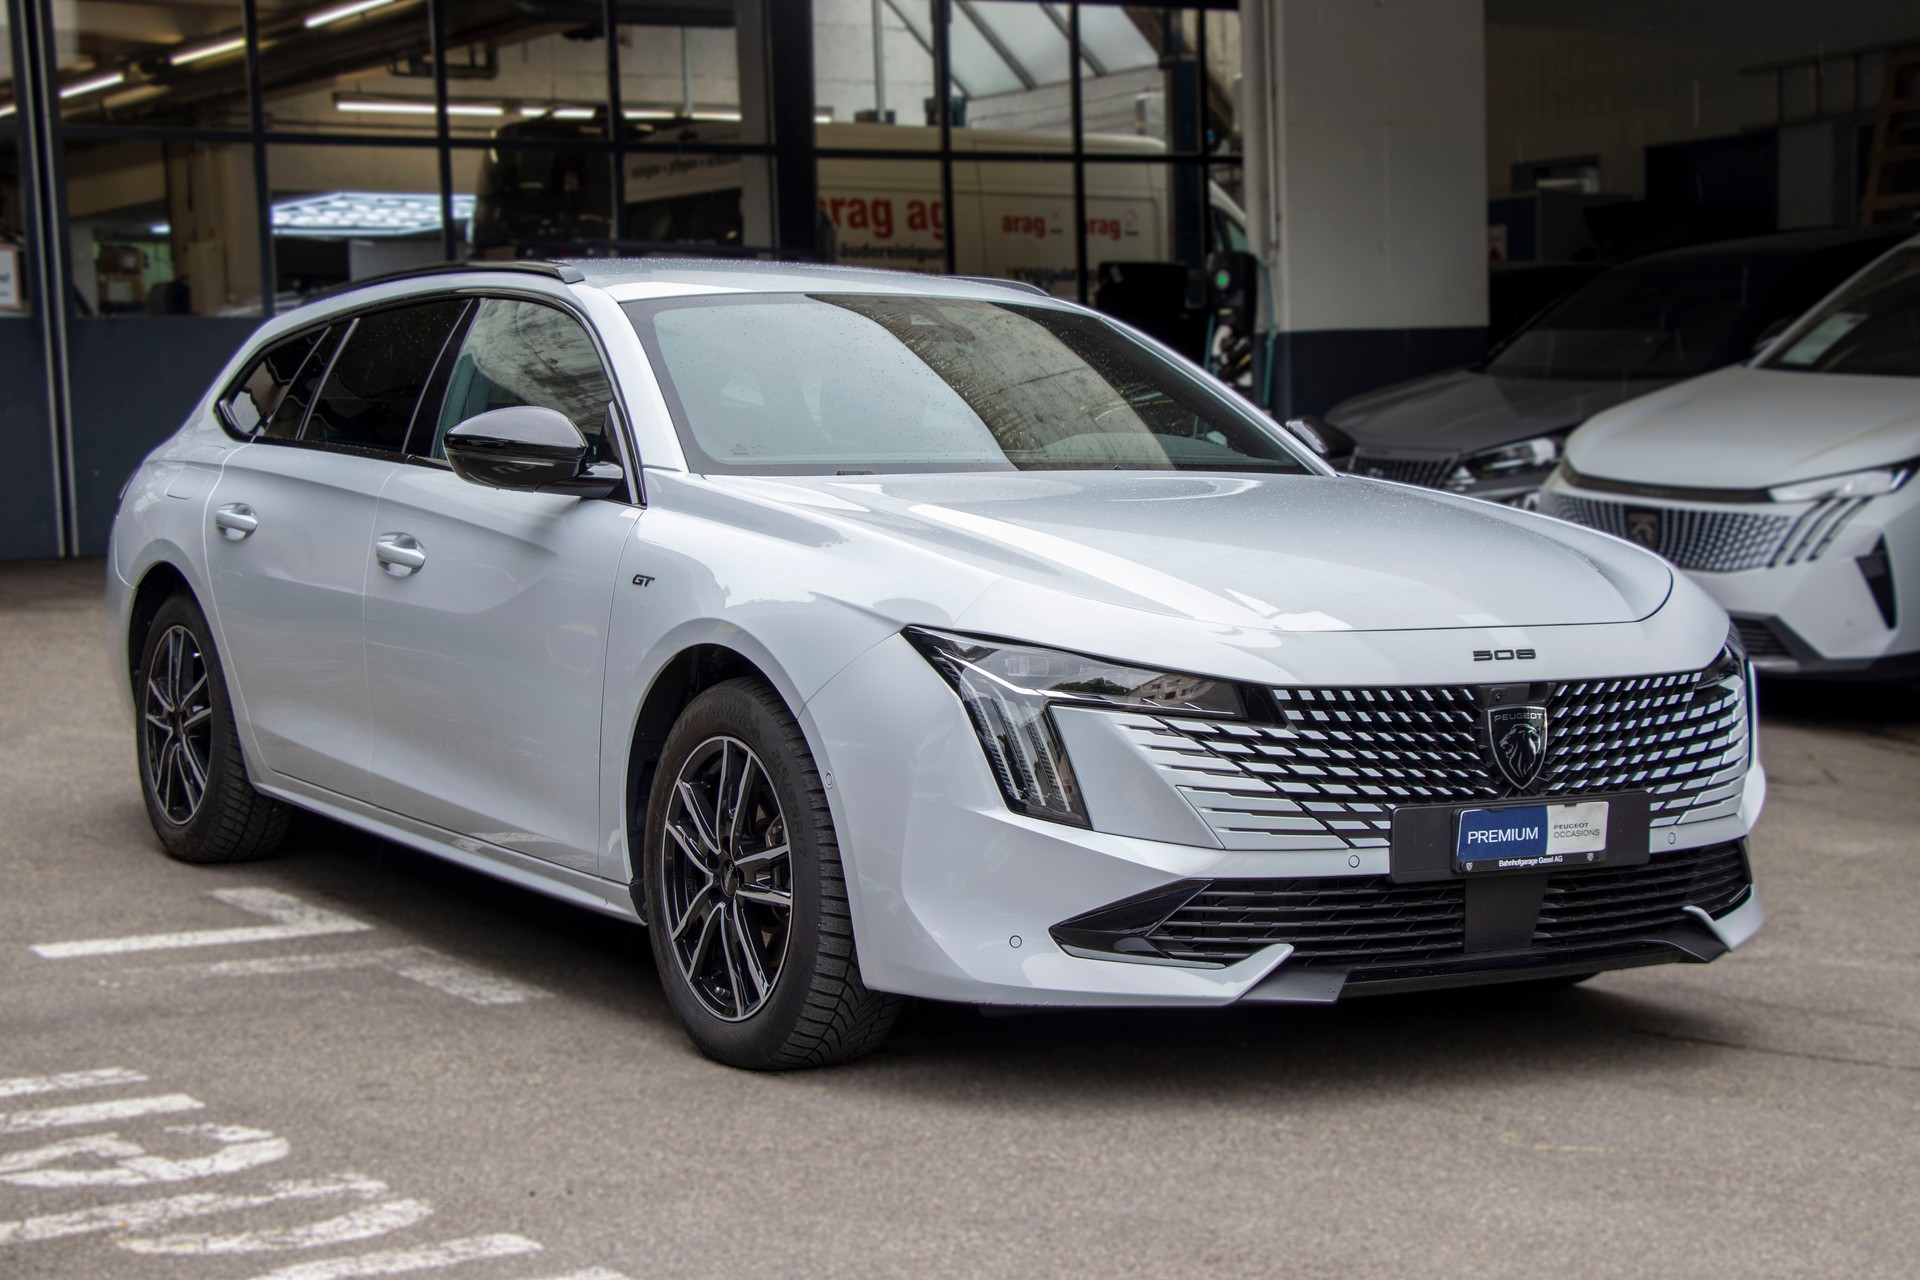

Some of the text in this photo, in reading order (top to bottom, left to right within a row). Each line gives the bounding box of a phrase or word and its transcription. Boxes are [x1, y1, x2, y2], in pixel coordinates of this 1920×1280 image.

[818, 196, 894, 239] rag
[1001, 214, 1046, 239] arag
[632, 574, 656, 588] GT
[1473, 649, 1536, 661] 508
[1494, 711, 1543, 722] PEUGEOT
[1467, 826, 1539, 845] PREMIUM
[1553, 828, 1601, 839] OCCASIONS
[1499, 858, 1538, 868] Bahnhofgarage
